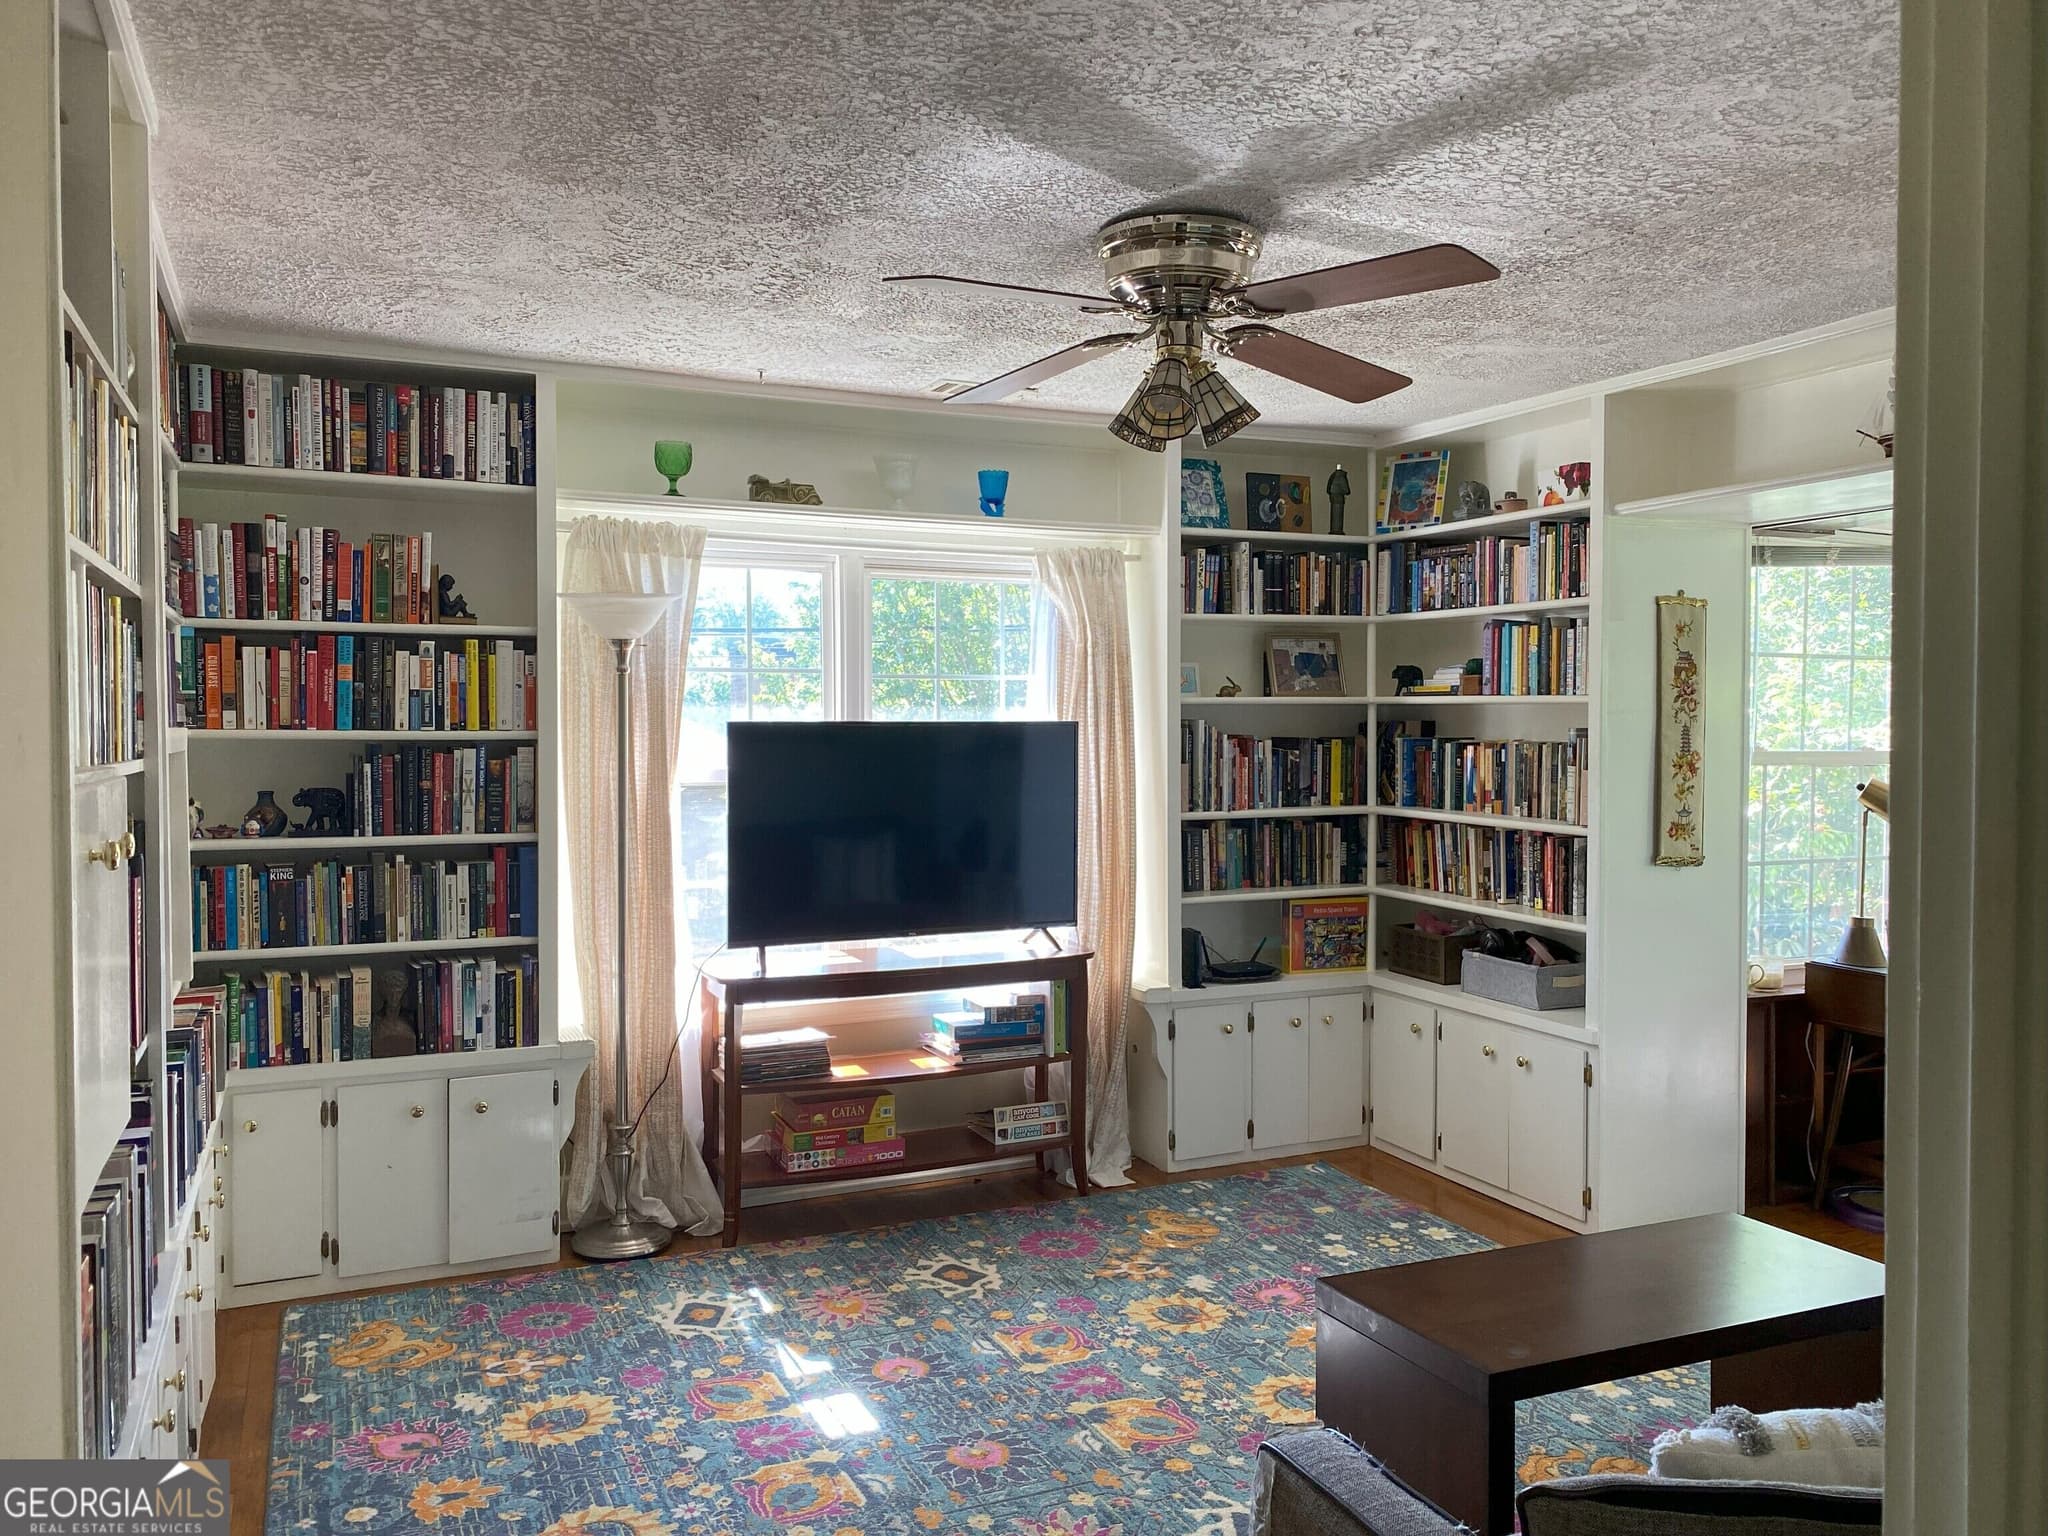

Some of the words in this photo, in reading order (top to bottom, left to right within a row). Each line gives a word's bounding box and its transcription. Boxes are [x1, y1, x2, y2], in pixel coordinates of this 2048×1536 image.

[376, 388, 384, 418] FRANCIS
[376, 420, 384, 457] FUKUYAMA
[396, 552, 406, 580] VIETNAM
[236, 574, 244, 600] Animals
[208, 656, 218, 688] COLLAPSE
[270, 872, 294, 880] KING
[231, 982, 239, 996] The
[231, 998, 239, 1020] Brain
[231, 1022, 239, 1042] Bible
[832, 1104, 865, 1119] CATAN
[1014, 1108, 1040, 1118] anyone
[1015, 1124, 1040, 1134] anyone
[824, 1134, 840, 1142] Century
[874, 1150, 904, 1160] 1000
